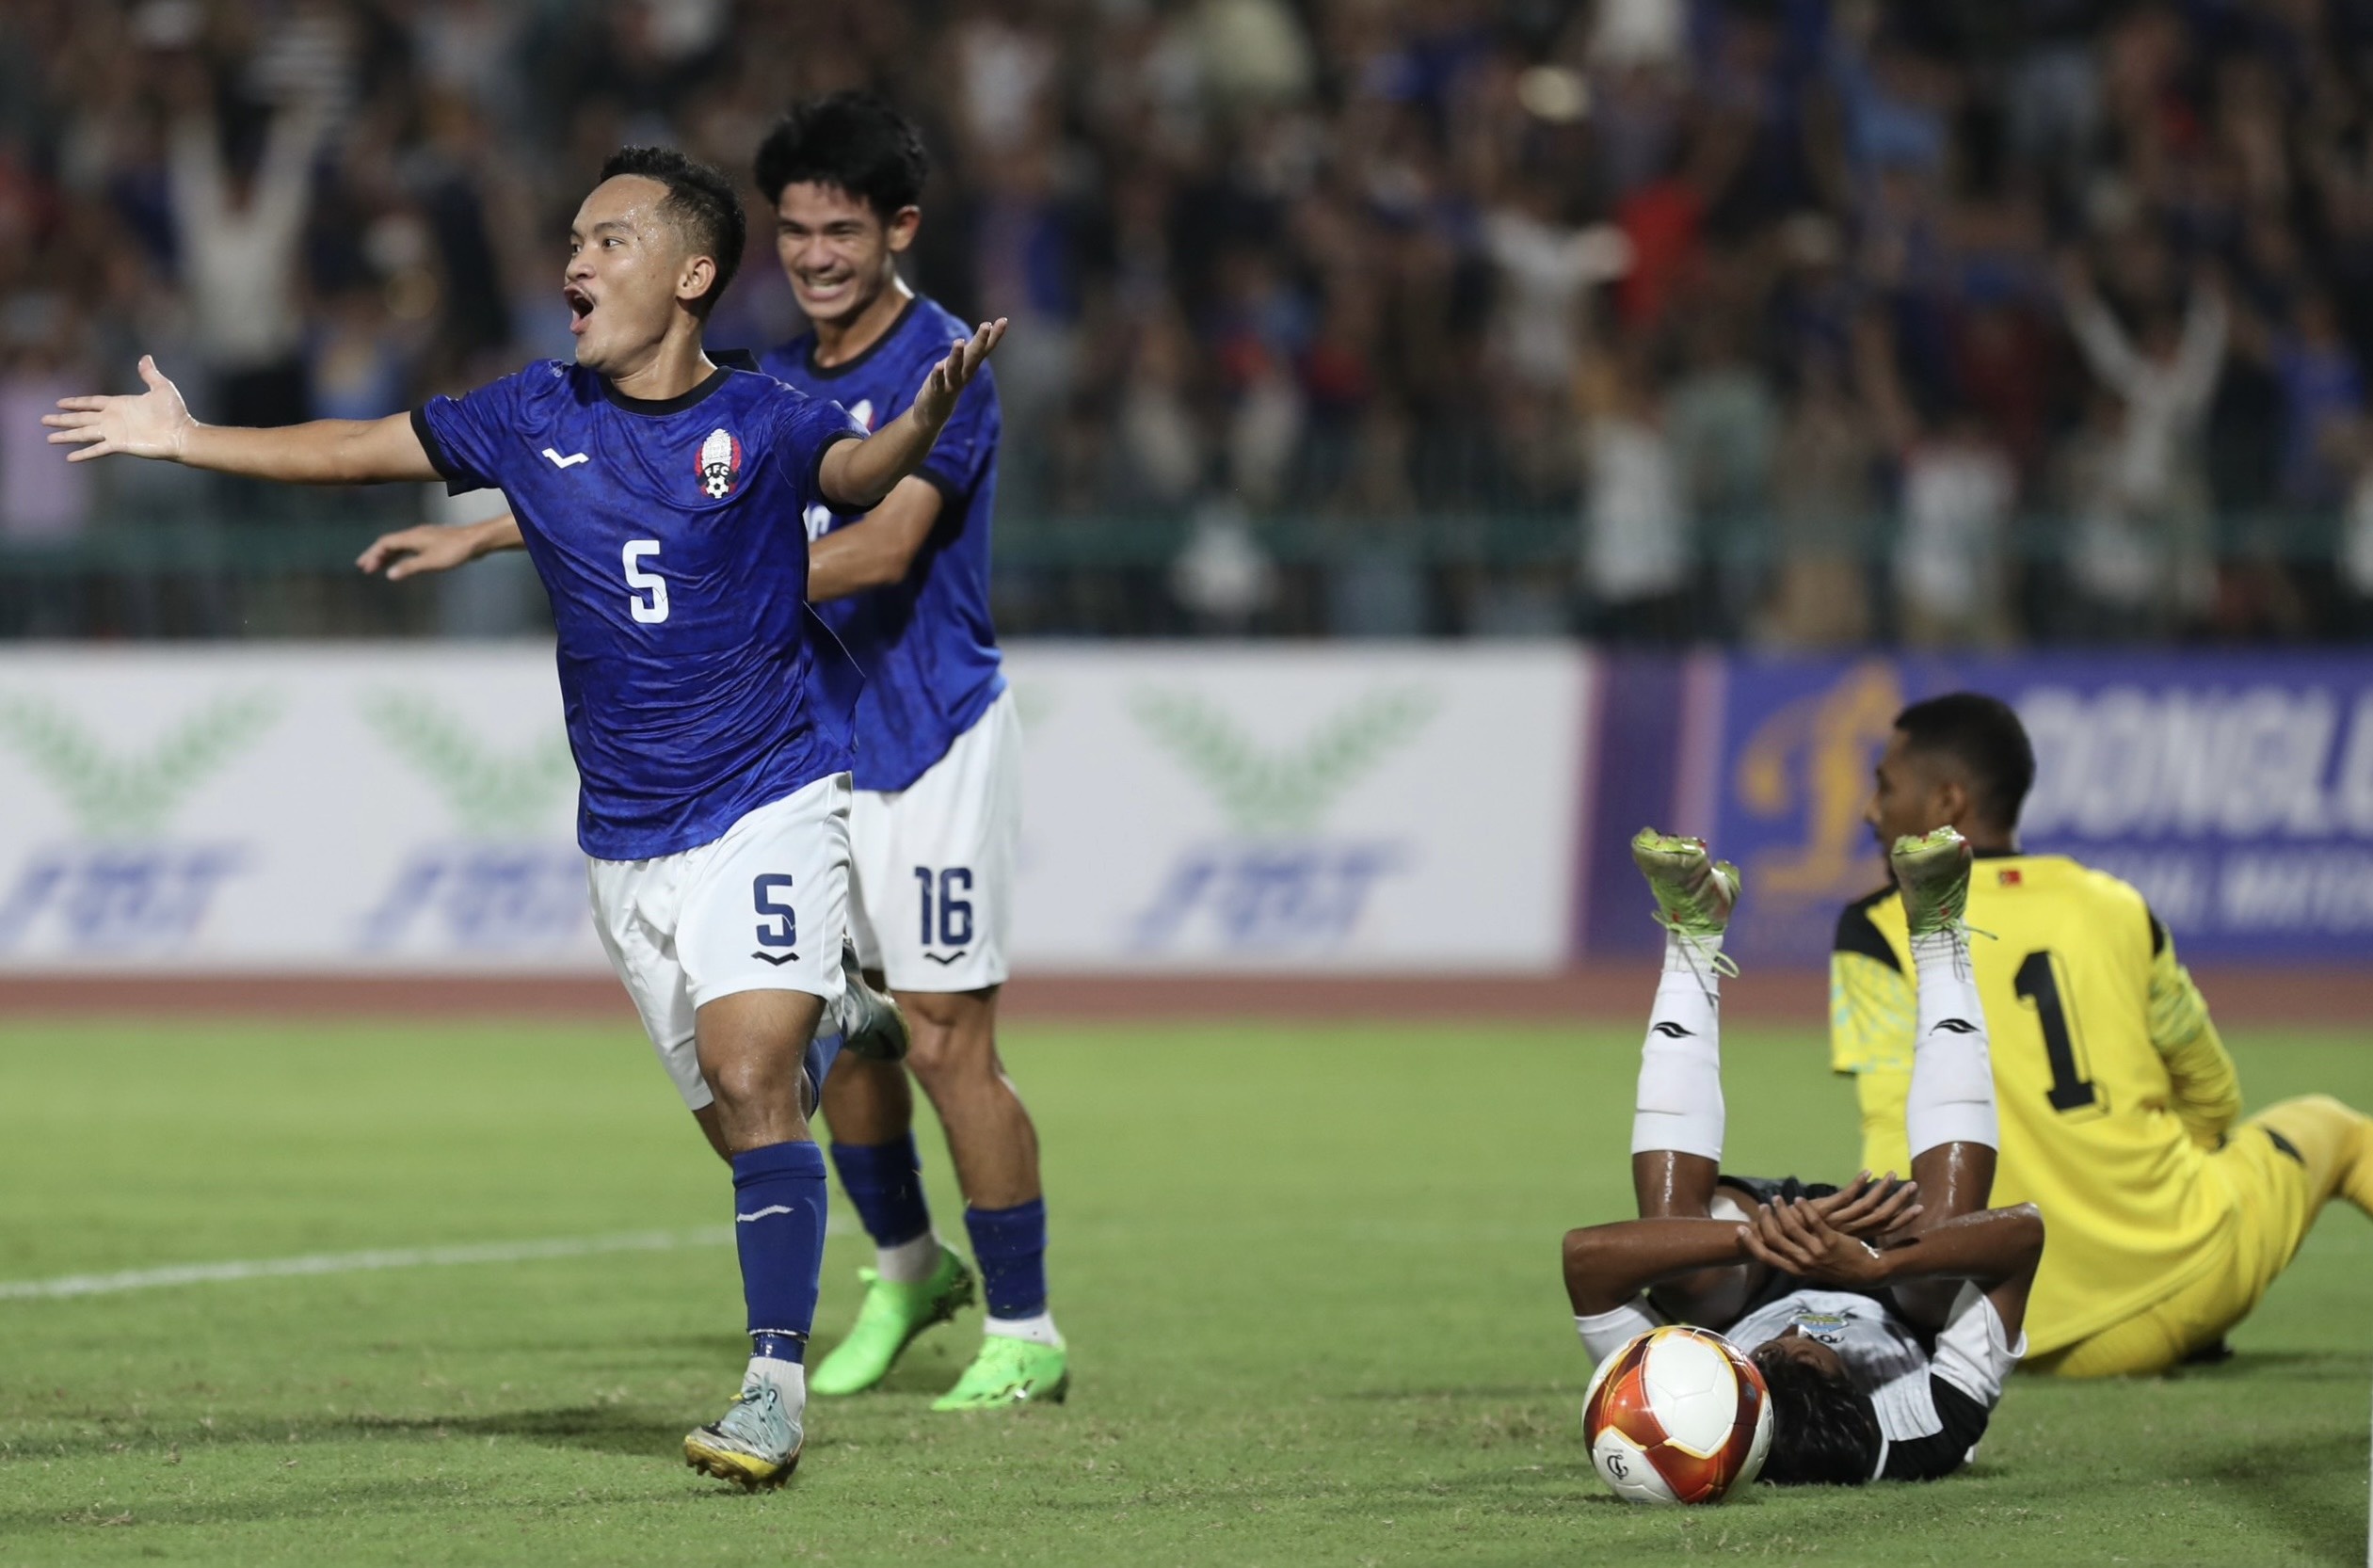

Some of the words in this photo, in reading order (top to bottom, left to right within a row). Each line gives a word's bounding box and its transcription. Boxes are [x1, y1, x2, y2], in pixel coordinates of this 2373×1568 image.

[704, 464, 730, 477] FFC
[622, 539, 669, 623] 5
[753, 873, 796, 947] 5
[915, 866, 972, 945] 16
[2013, 951, 2101, 1114] 1
